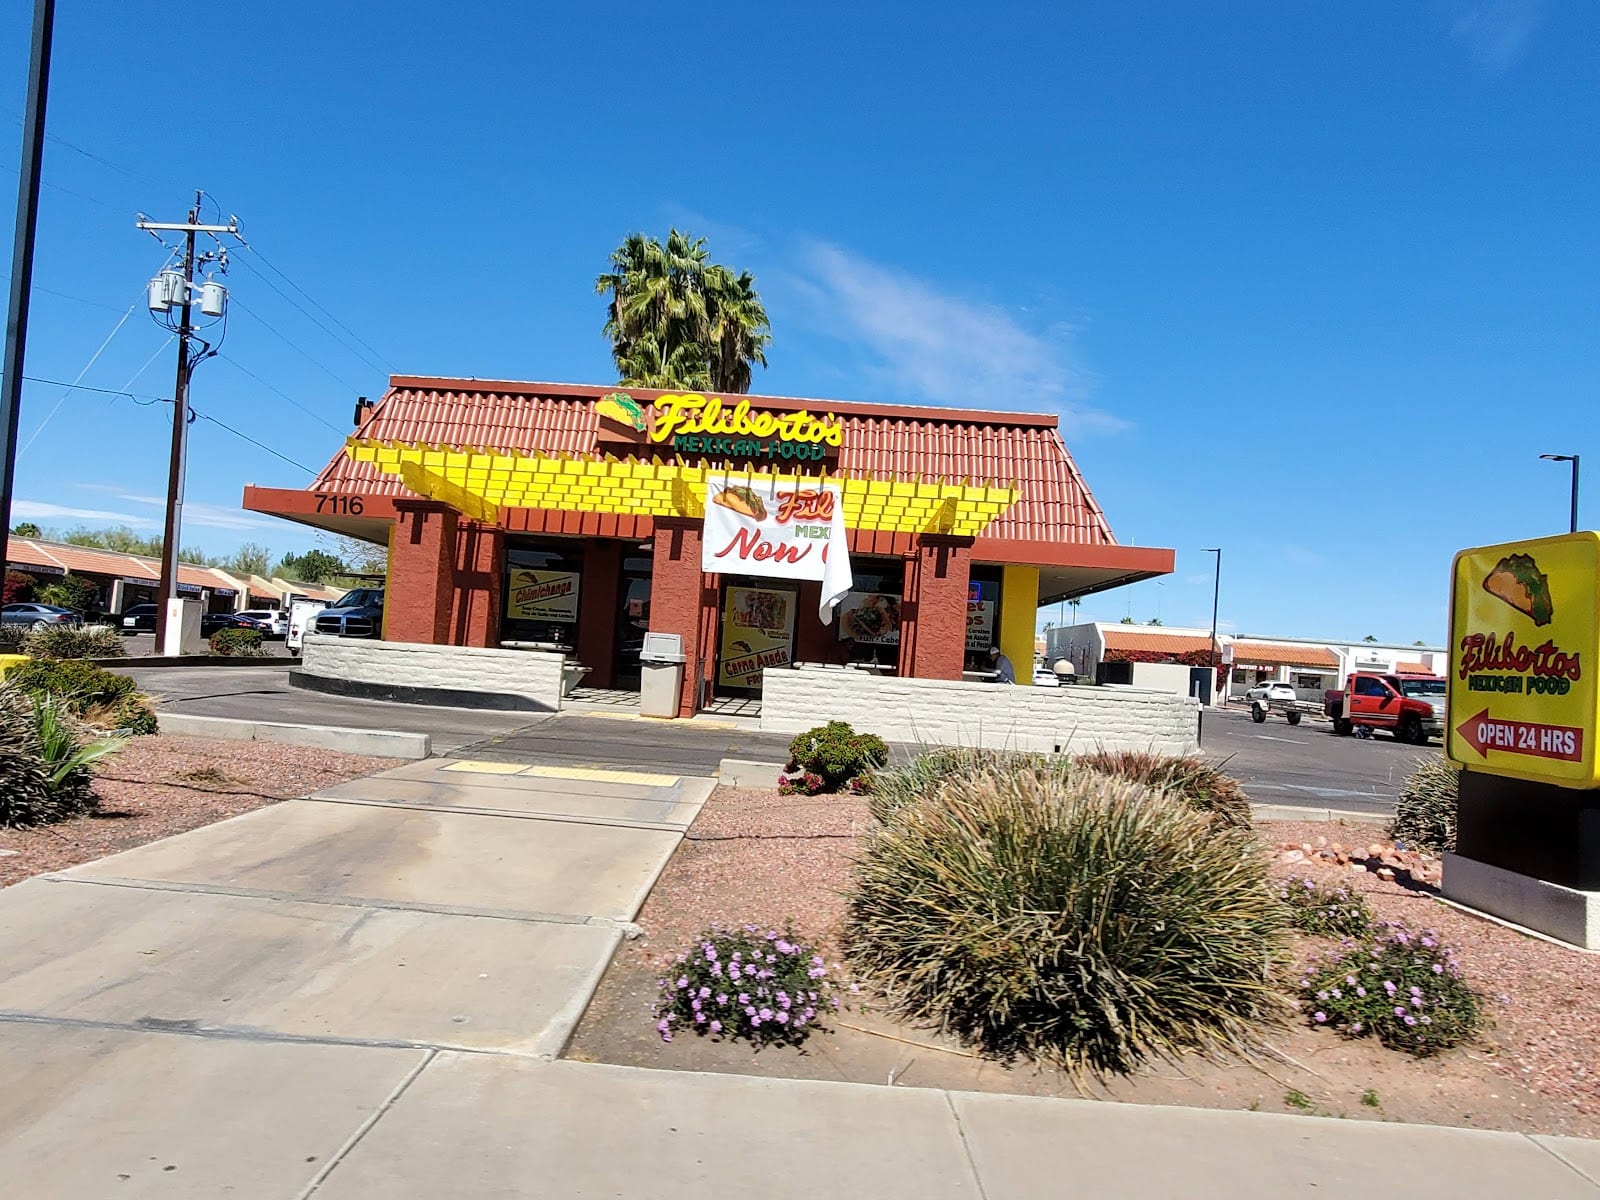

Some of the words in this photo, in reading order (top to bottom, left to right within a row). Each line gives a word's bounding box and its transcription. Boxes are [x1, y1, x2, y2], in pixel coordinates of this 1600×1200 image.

[650, 394, 842, 446] Filiberto's
[674, 434, 761, 457] MEXICAN
[767, 440, 825, 461] FOOD
[314, 494, 364, 515] 7116
[515, 581, 572, 604] Chimichanga
[724, 659, 755, 676] Carne
[756, 649, 789, 669] Asada
[1459, 631, 1581, 681] Filibertos
[1468, 674, 1523, 694] MEXICAN
[1526, 676, 1571, 696] FOOD
[1477, 722, 1515, 747] OPEN
[1518, 726, 1537, 750] 24
[1540, 728, 1577, 755] HRS
